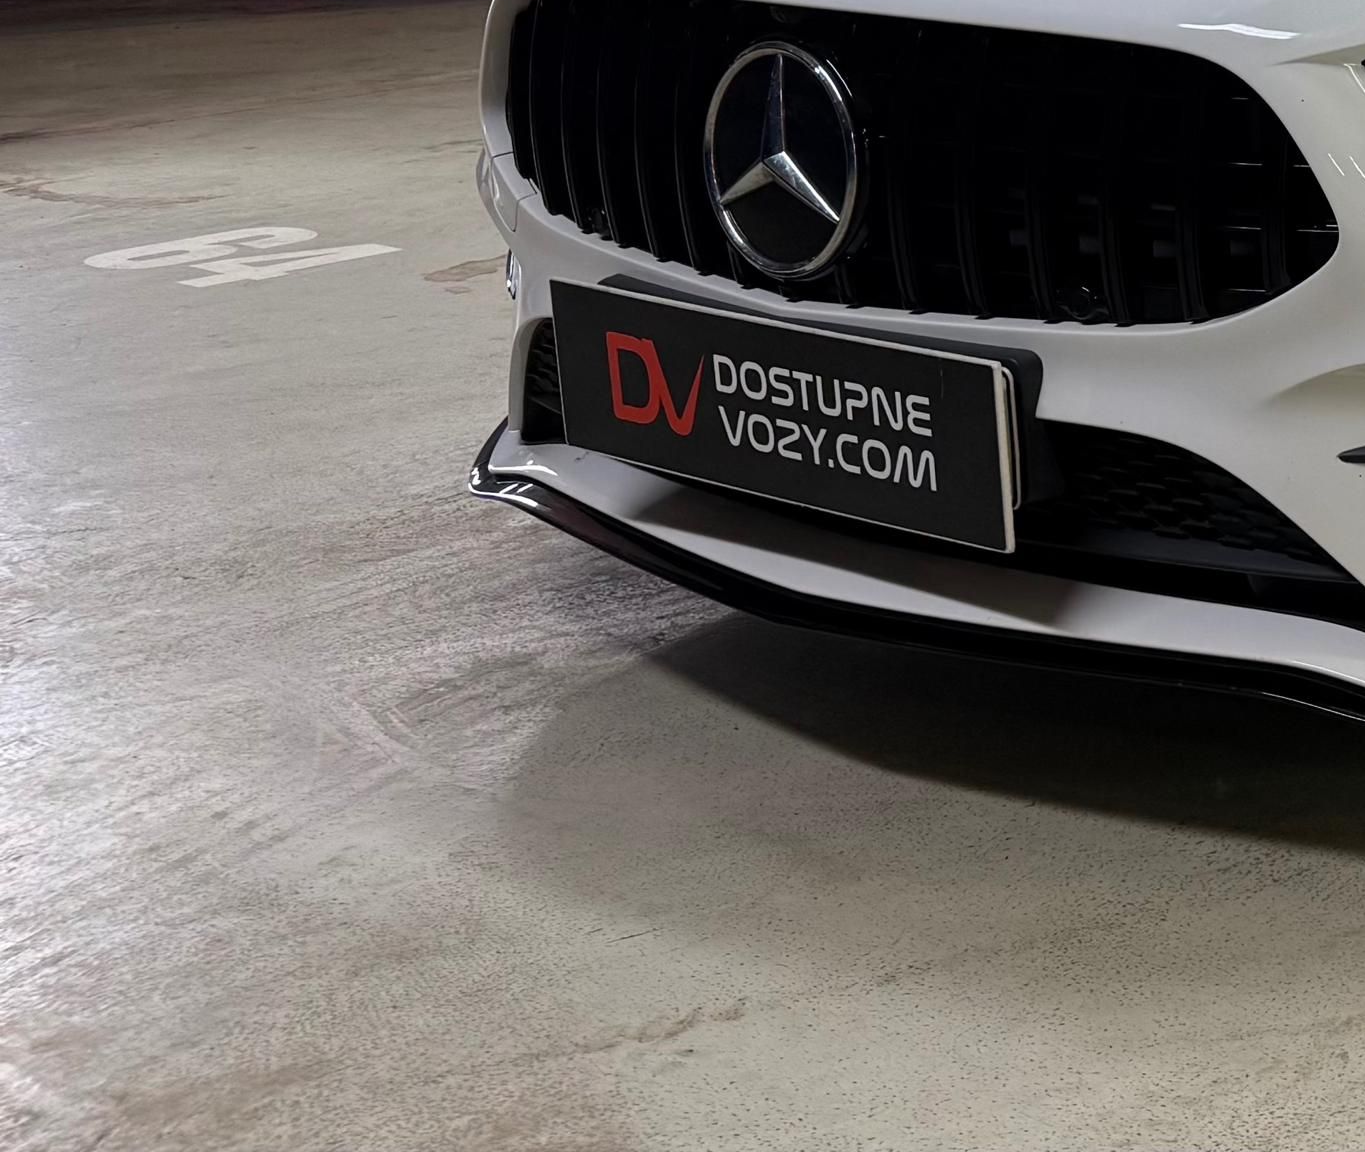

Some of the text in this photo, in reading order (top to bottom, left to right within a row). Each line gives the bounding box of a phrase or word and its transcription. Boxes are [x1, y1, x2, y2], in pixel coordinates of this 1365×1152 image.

[83, 226, 403, 288] 64
[712, 353, 933, 438] DOSTUPNE
[718, 404, 938, 493] VOZY.COM
